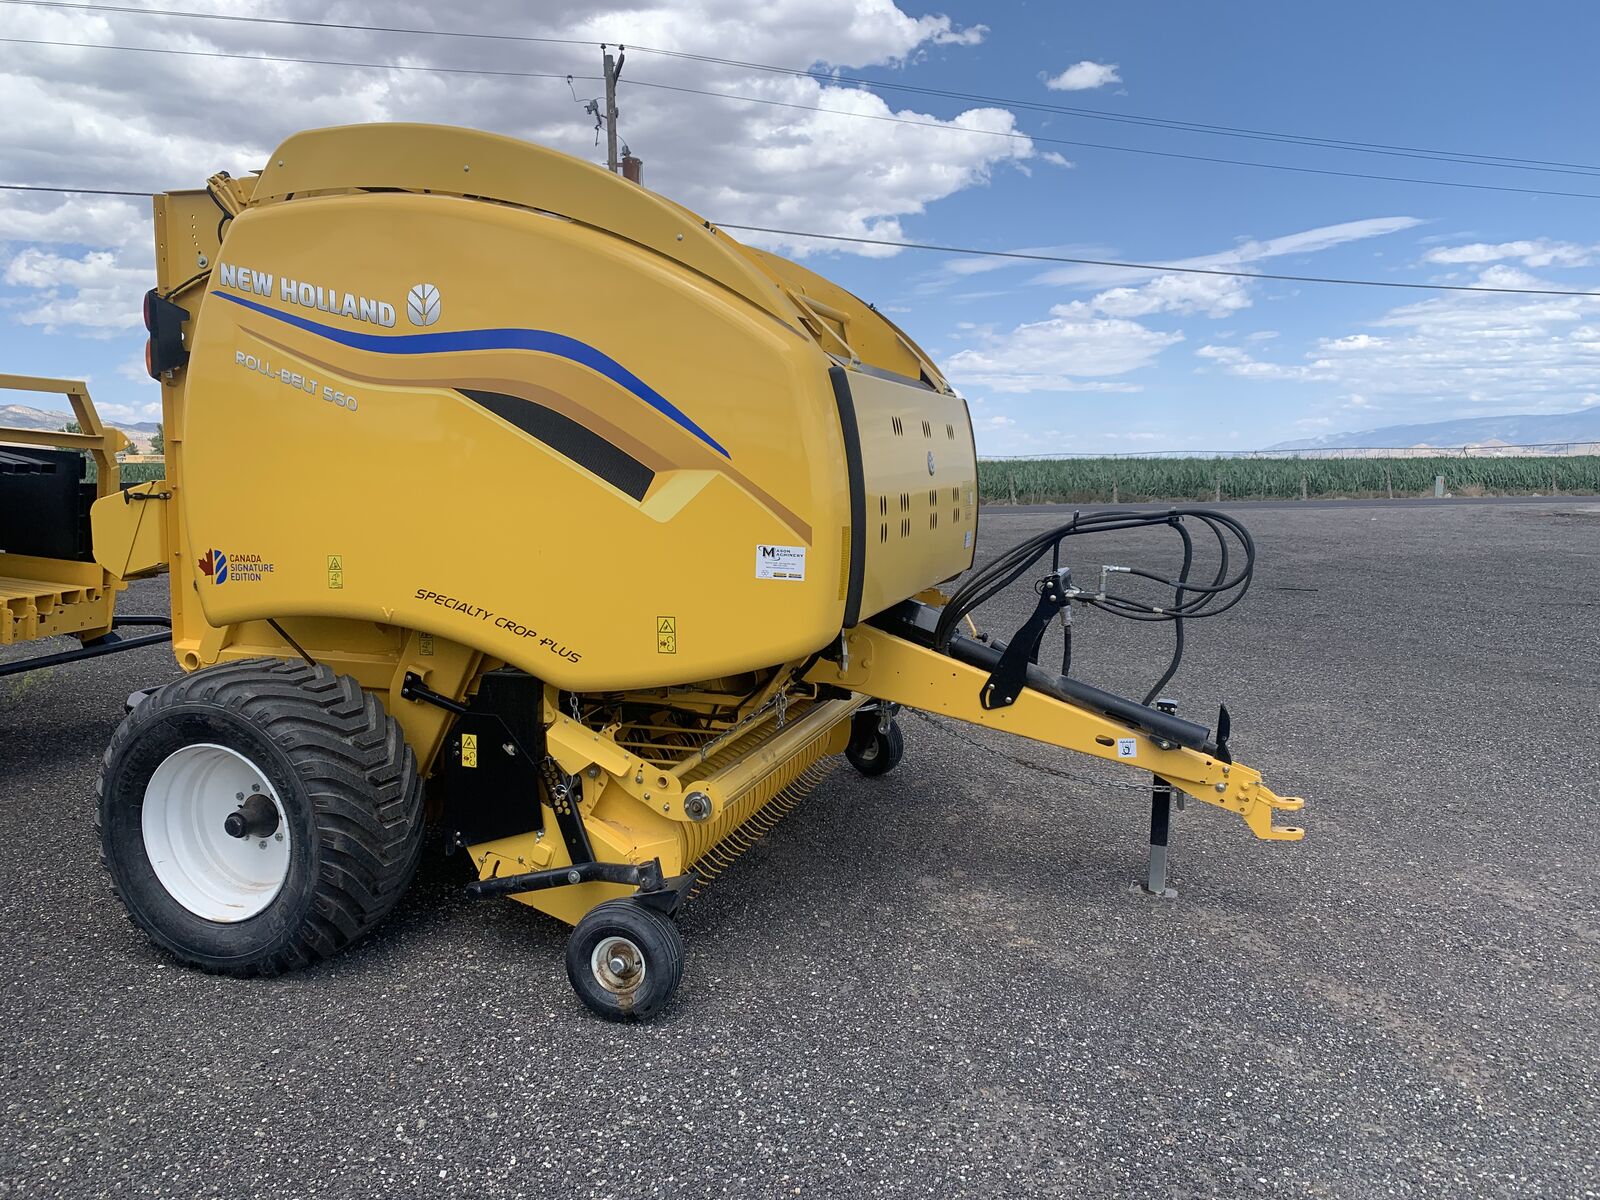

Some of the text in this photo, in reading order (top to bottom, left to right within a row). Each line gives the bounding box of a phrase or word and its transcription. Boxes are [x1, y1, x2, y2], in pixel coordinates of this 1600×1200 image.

[220, 262, 396, 328] NEW HOLLAND
[235, 350, 318, 394] ROLL-BELT
[229, 554, 261, 563] CANADA
[230, 563, 274, 573] SIGNATURE
[230, 573, 261, 581] EDITION
[415, 589, 493, 620] SPECIALTY
[494, 617, 537, 638] CROP
